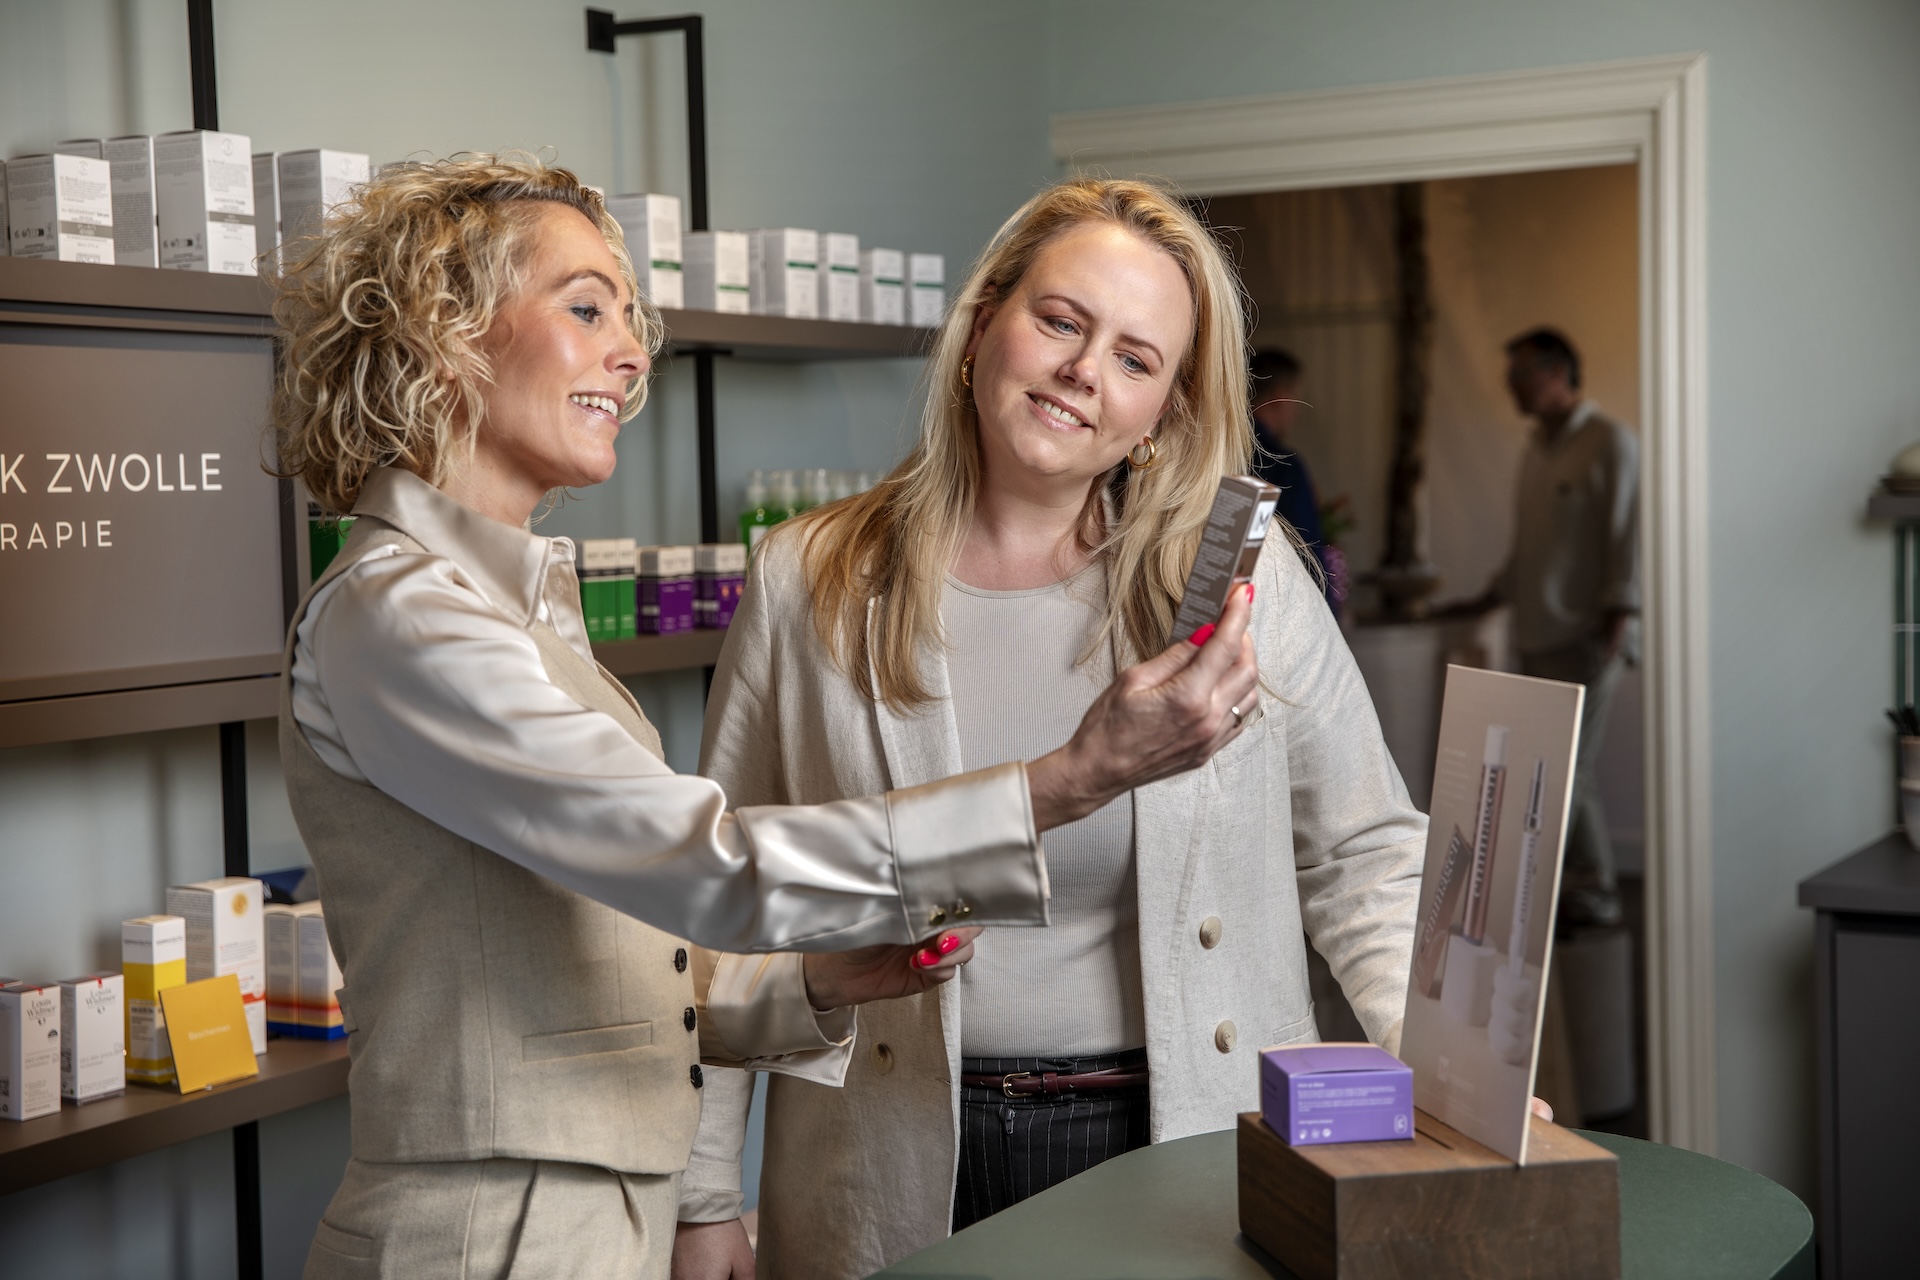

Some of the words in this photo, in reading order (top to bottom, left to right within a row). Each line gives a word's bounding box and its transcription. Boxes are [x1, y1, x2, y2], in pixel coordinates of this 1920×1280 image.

[0, 453, 27, 494] K
[46, 452, 223, 493] ZWOLLE
[0, 520, 113, 551] RAPIE
